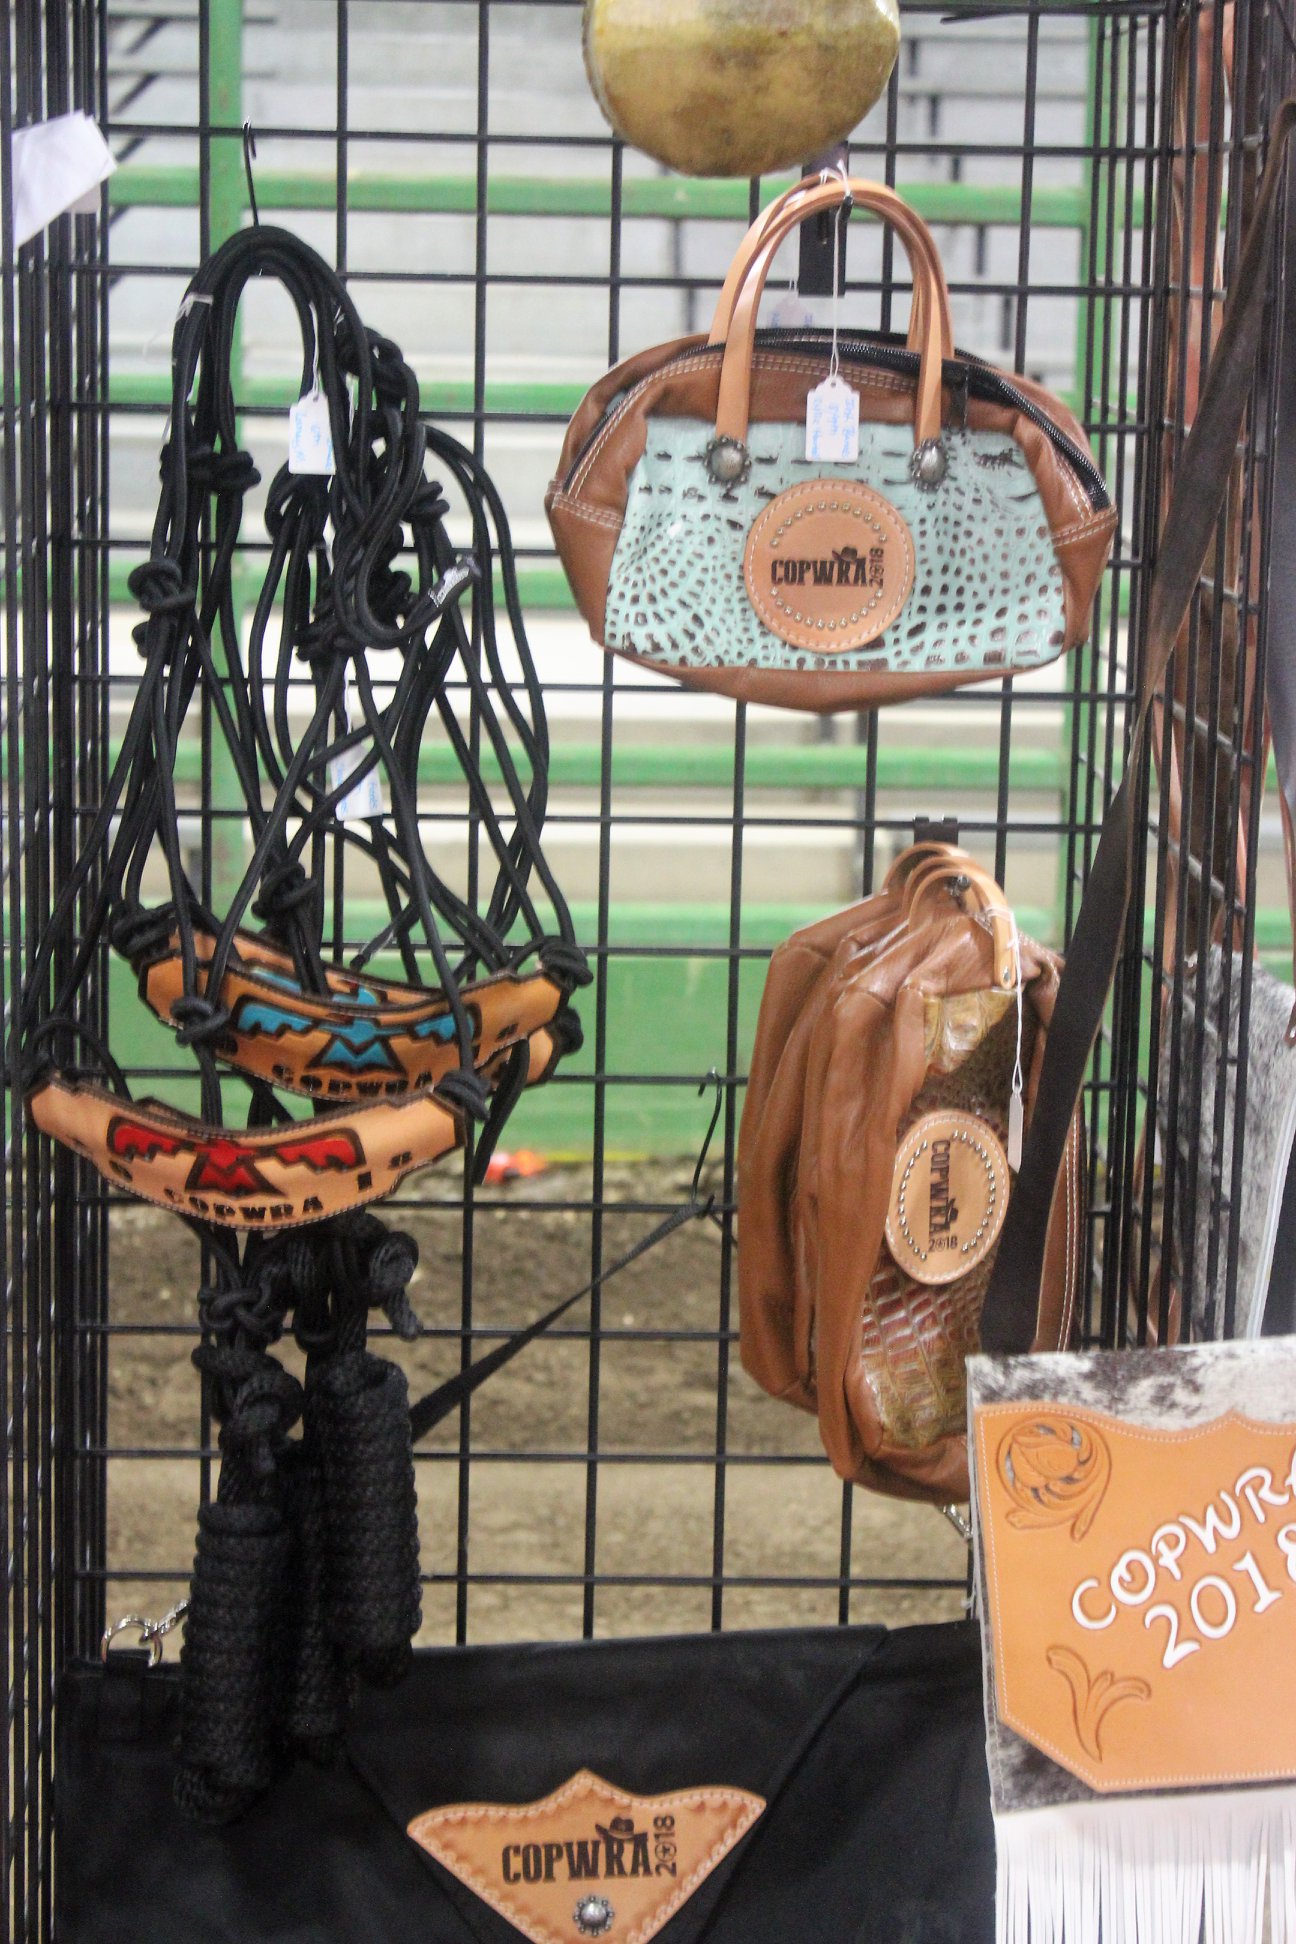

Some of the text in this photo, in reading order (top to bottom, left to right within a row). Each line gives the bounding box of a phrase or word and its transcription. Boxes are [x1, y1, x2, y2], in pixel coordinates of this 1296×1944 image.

[771, 557, 867, 587] COPWRA
[929, 1139, 950, 1235] COPWRA
[502, 1831, 652, 1885] COPWRA
